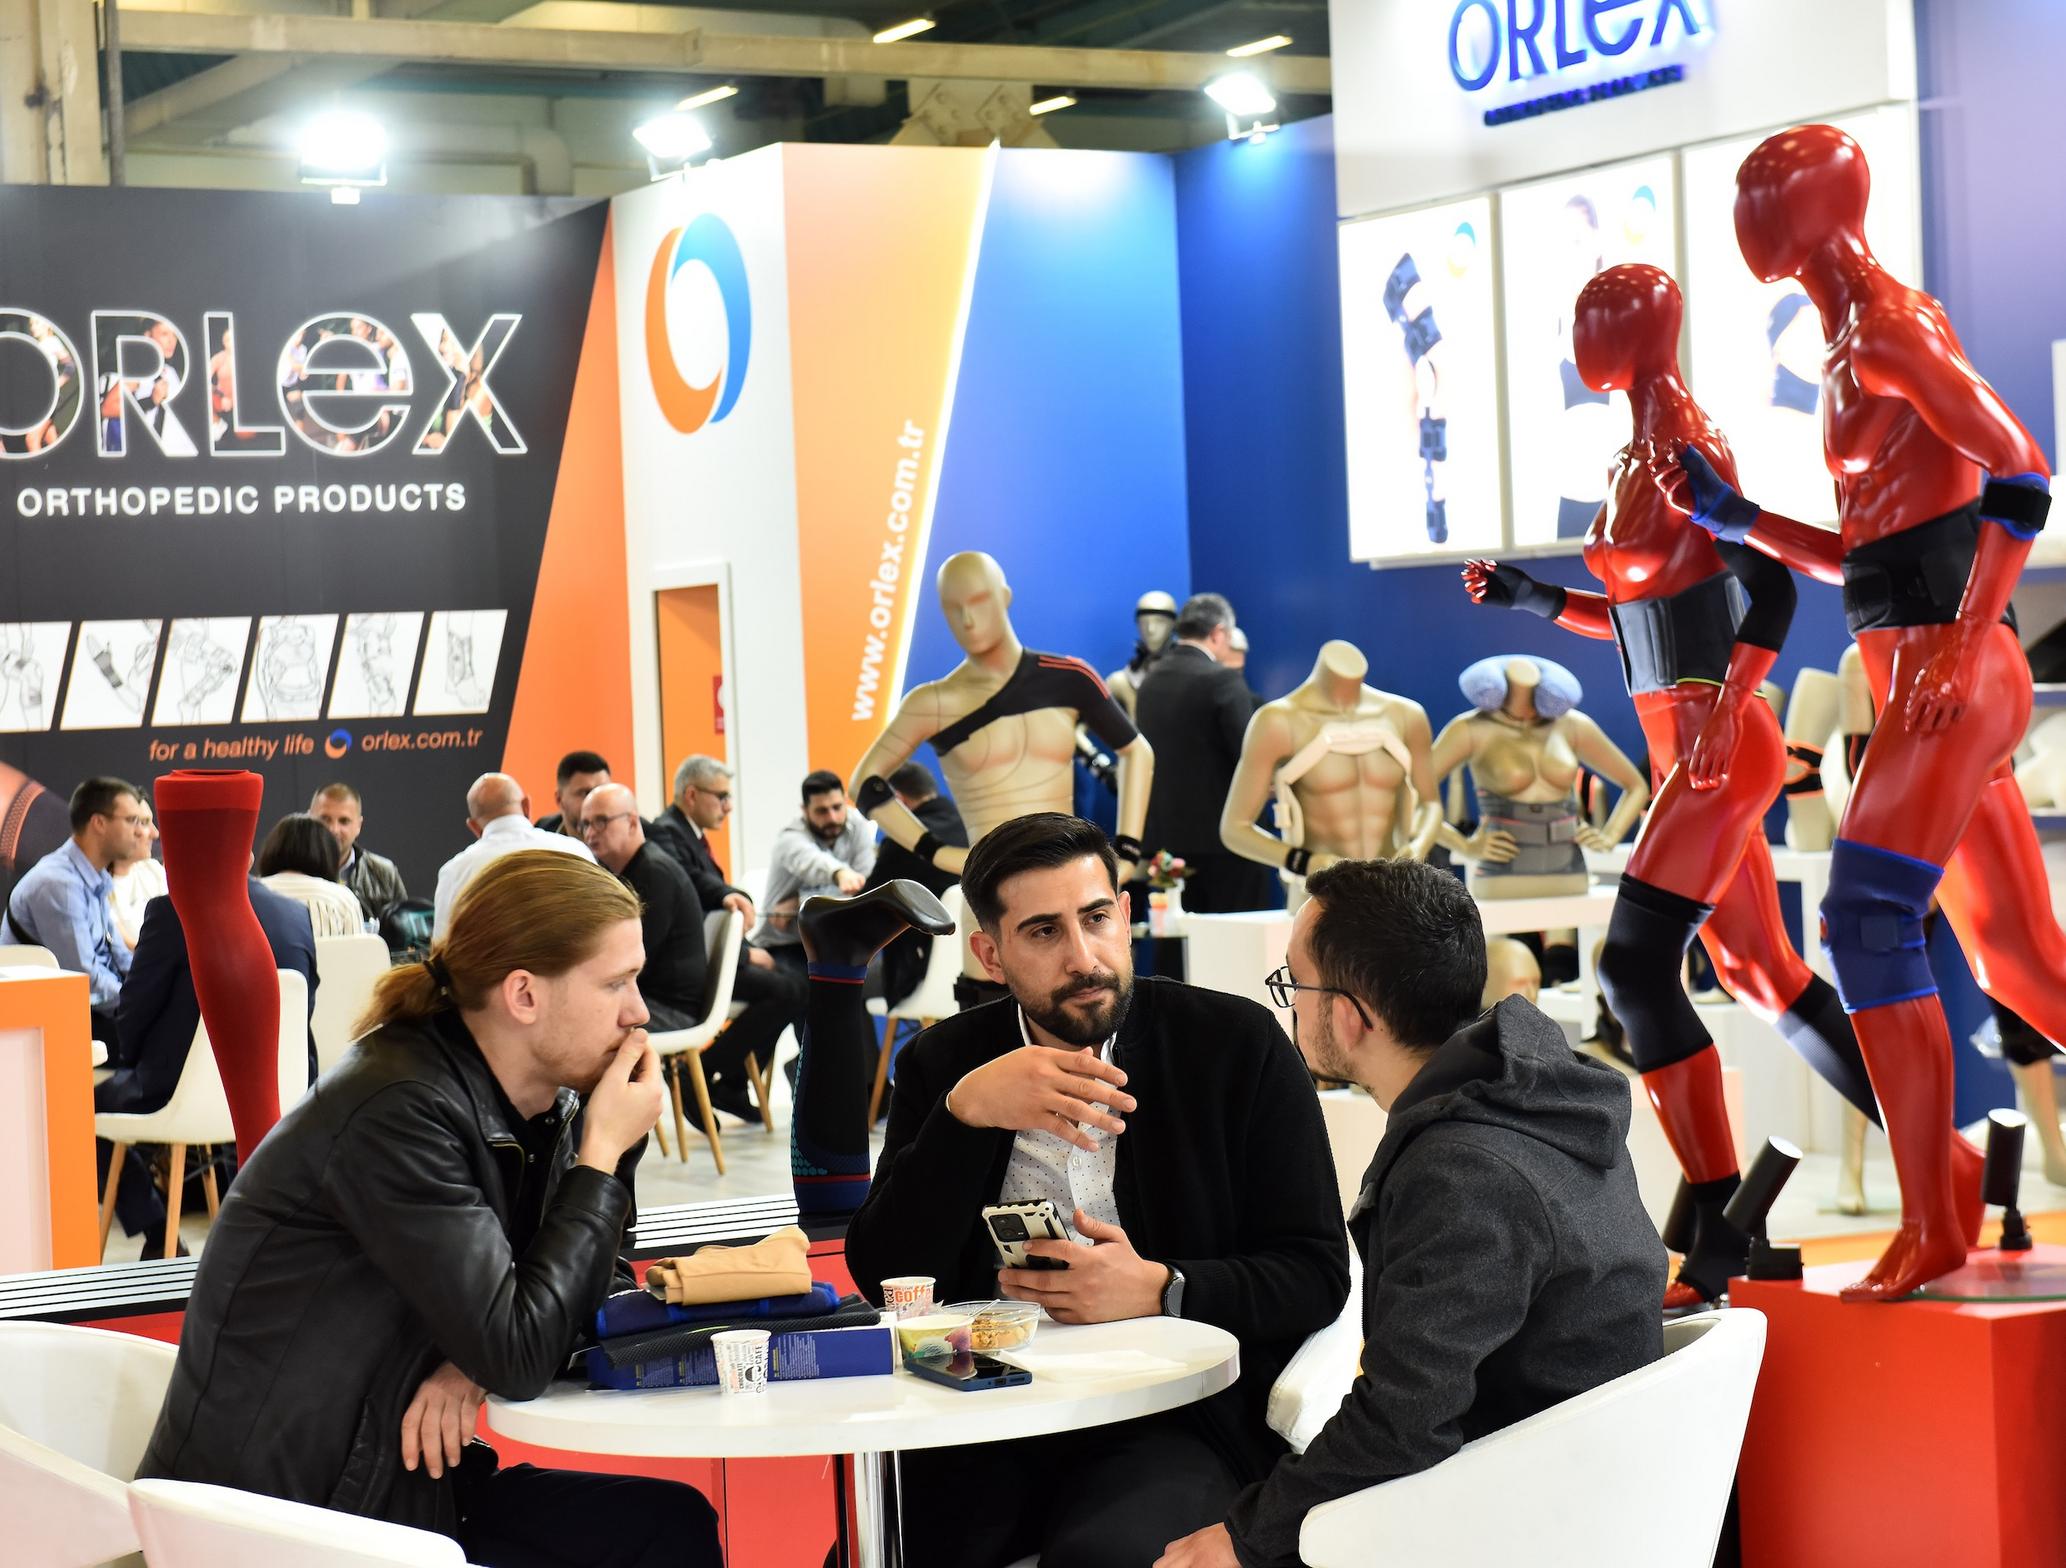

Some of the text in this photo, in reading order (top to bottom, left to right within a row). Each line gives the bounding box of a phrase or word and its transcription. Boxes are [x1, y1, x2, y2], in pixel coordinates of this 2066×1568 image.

[16, 482, 467, 518] ORTHOPEDIC PRODUCTS
[851, 419, 925, 721] www.orlex.com.tr
[149, 732, 315, 762] for a healthy life
[361, 727, 484, 752] orlex.com.tr
